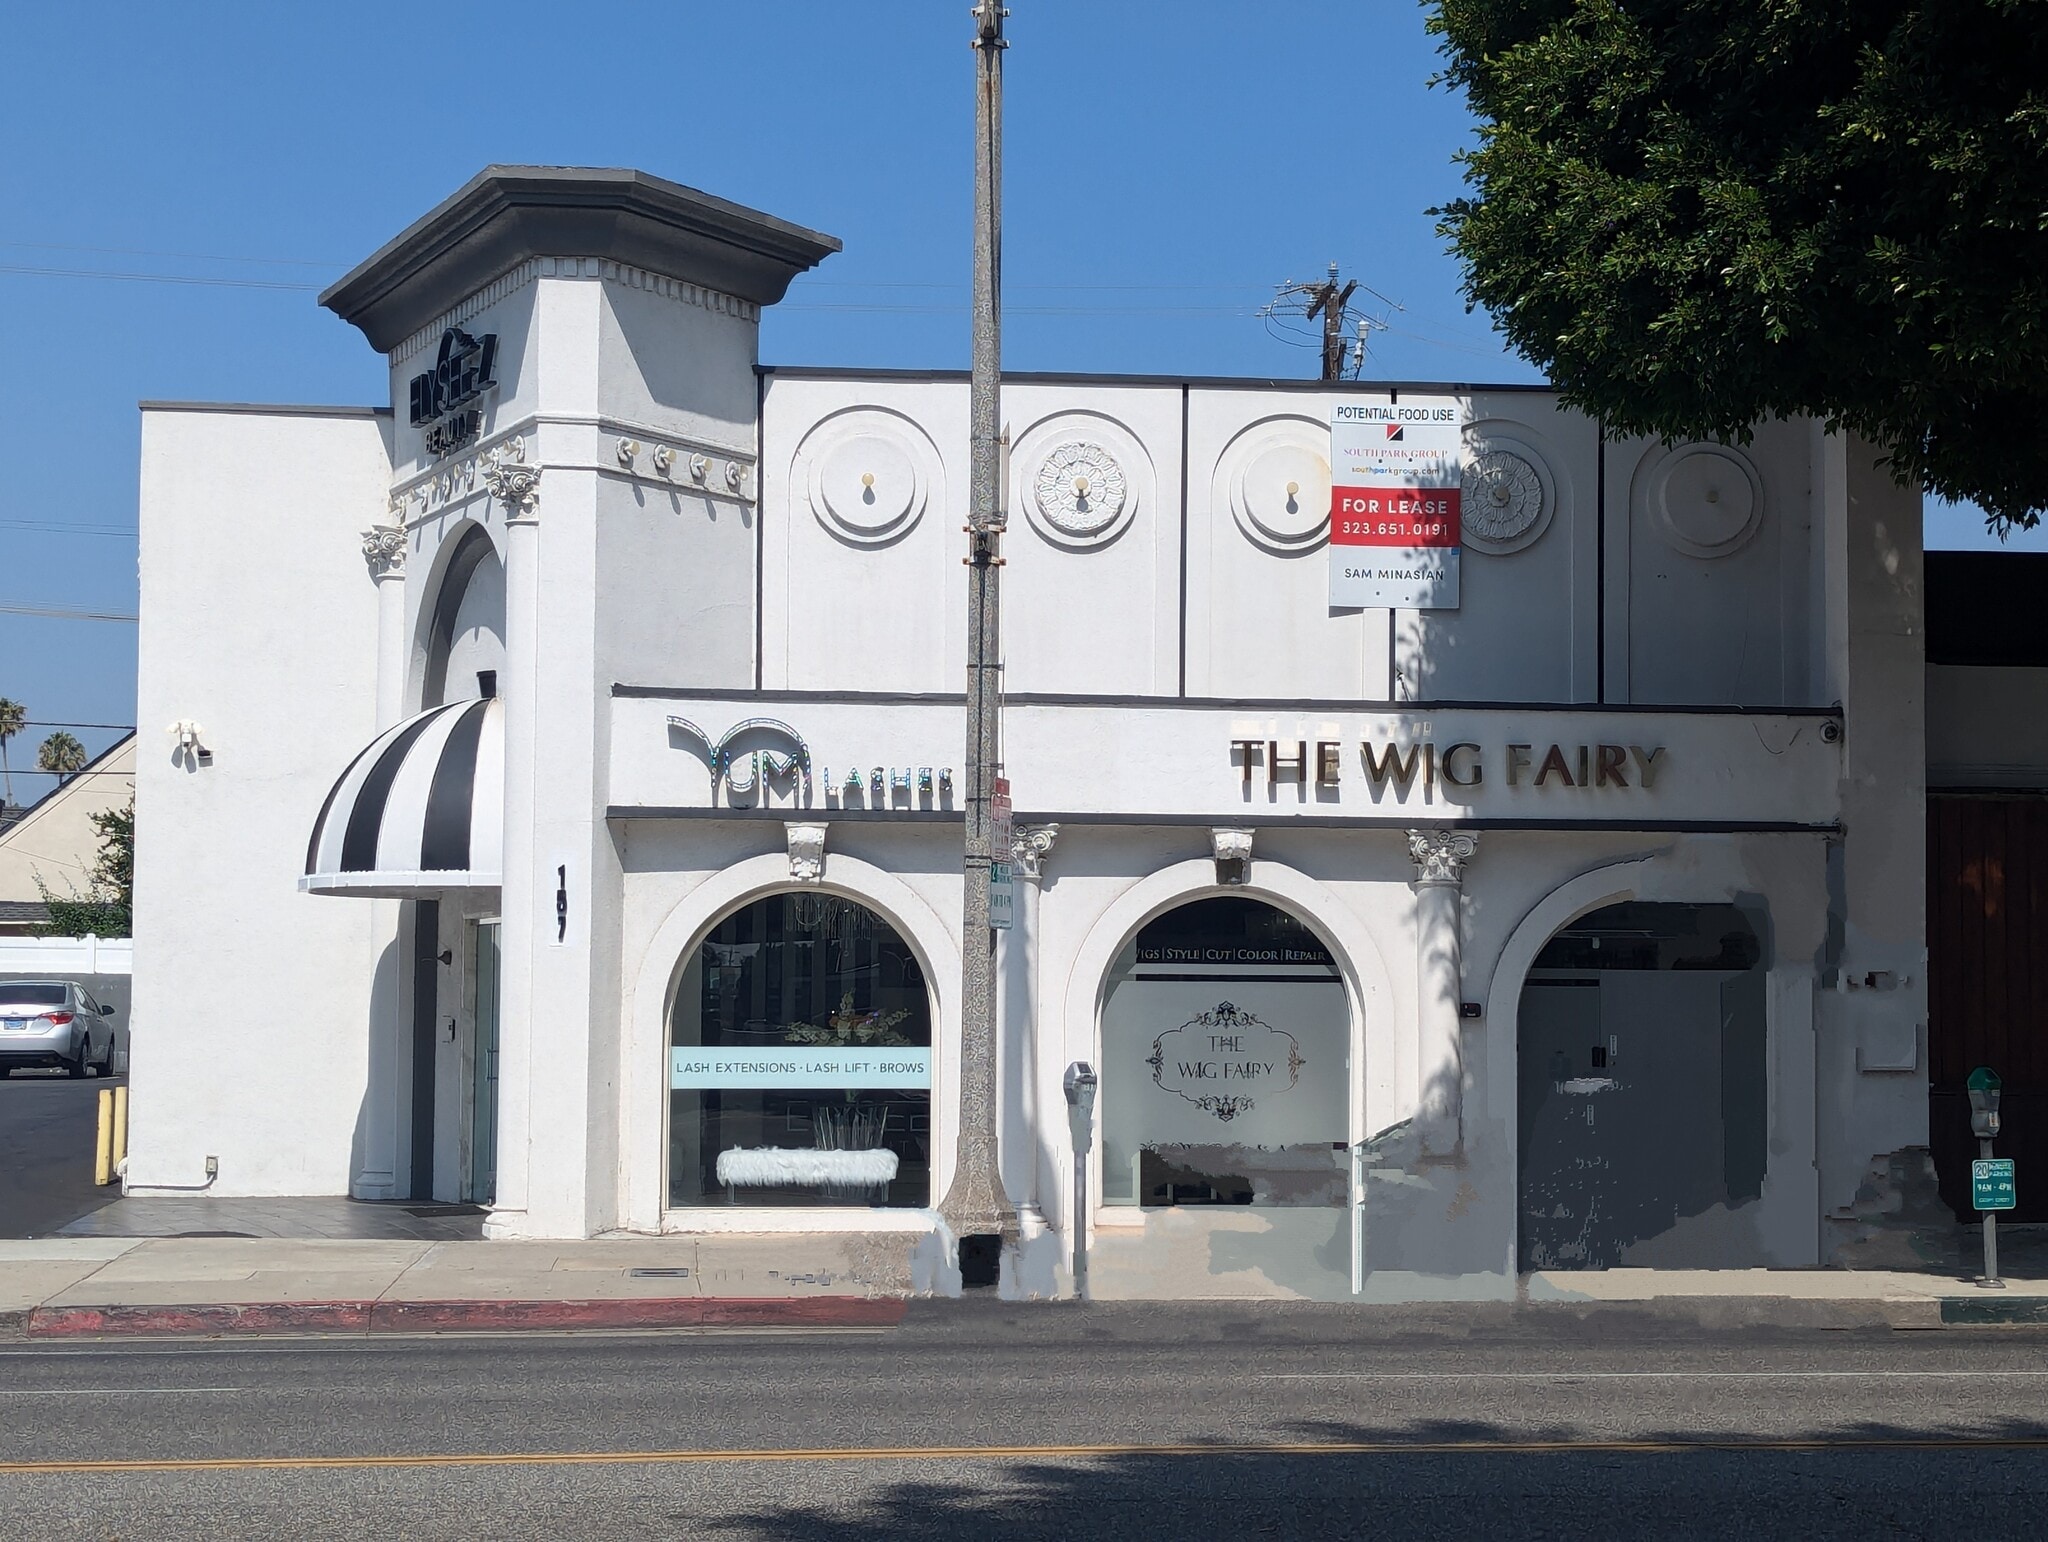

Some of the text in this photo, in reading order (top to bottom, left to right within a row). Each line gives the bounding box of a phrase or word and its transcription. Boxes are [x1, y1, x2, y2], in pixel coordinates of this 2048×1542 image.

[1337, 406, 1454, 421] POTENTIAL FOOD USE
[1344, 448, 1448, 459] SOUTH PARK GROUP
[1351, 466, 1440, 476] southparkgroup.com
[1342, 498, 1448, 515] FOR LEASE
[1342, 521, 1449, 536] 323.651.0191
[1344, 568, 1445, 581] SAM MINASIAN
[1230, 740, 1667, 788] THE WIG FAIRY
[823, 766, 954, 796] LASHES
[1137, 948, 1326, 961] IGS STYLE CUT COLOR REPAIR
[1207, 1035, 1246, 1053] THE
[676, 1062, 925, 1074] LASH EXTENSIONS LASH LIFT BROWS
[1177, 1061, 1275, 1079] WIG FAIRY
